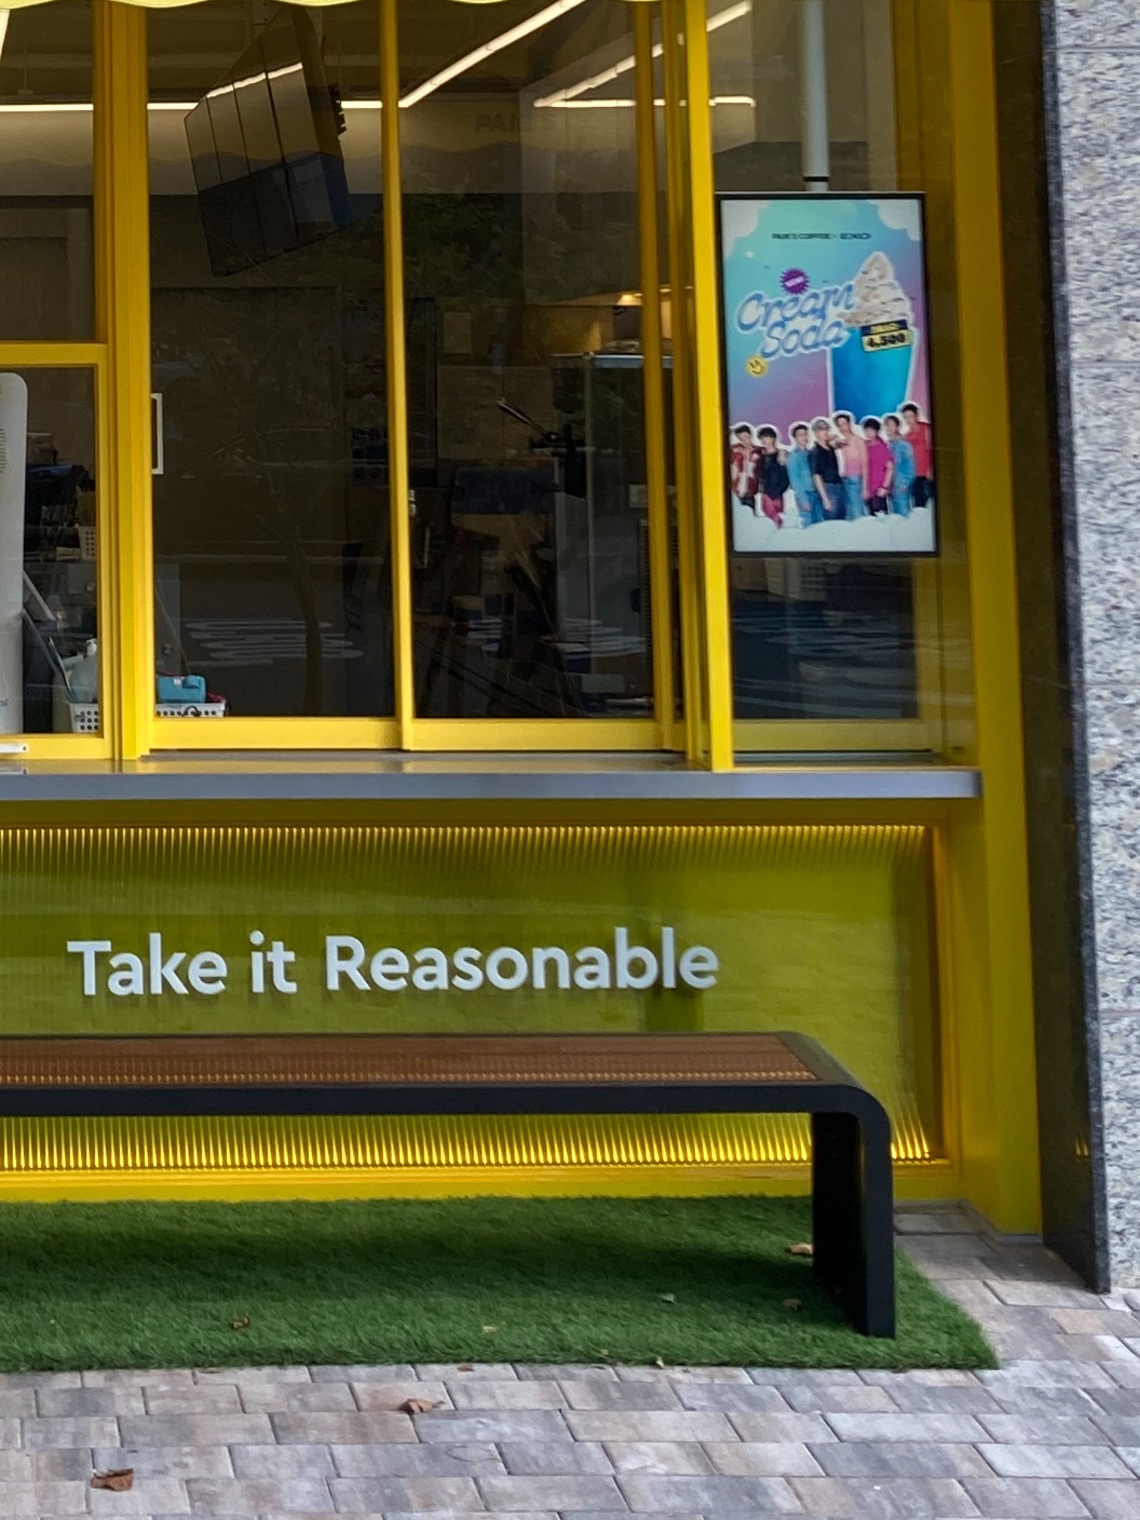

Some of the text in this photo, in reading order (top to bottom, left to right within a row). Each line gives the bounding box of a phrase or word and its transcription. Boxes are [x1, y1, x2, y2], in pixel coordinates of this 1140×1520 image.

[736, 283, 854, 332] Cream
[760, 320, 844, 358] Soda
[66, 925, 720, 996] Take it Reasonable
